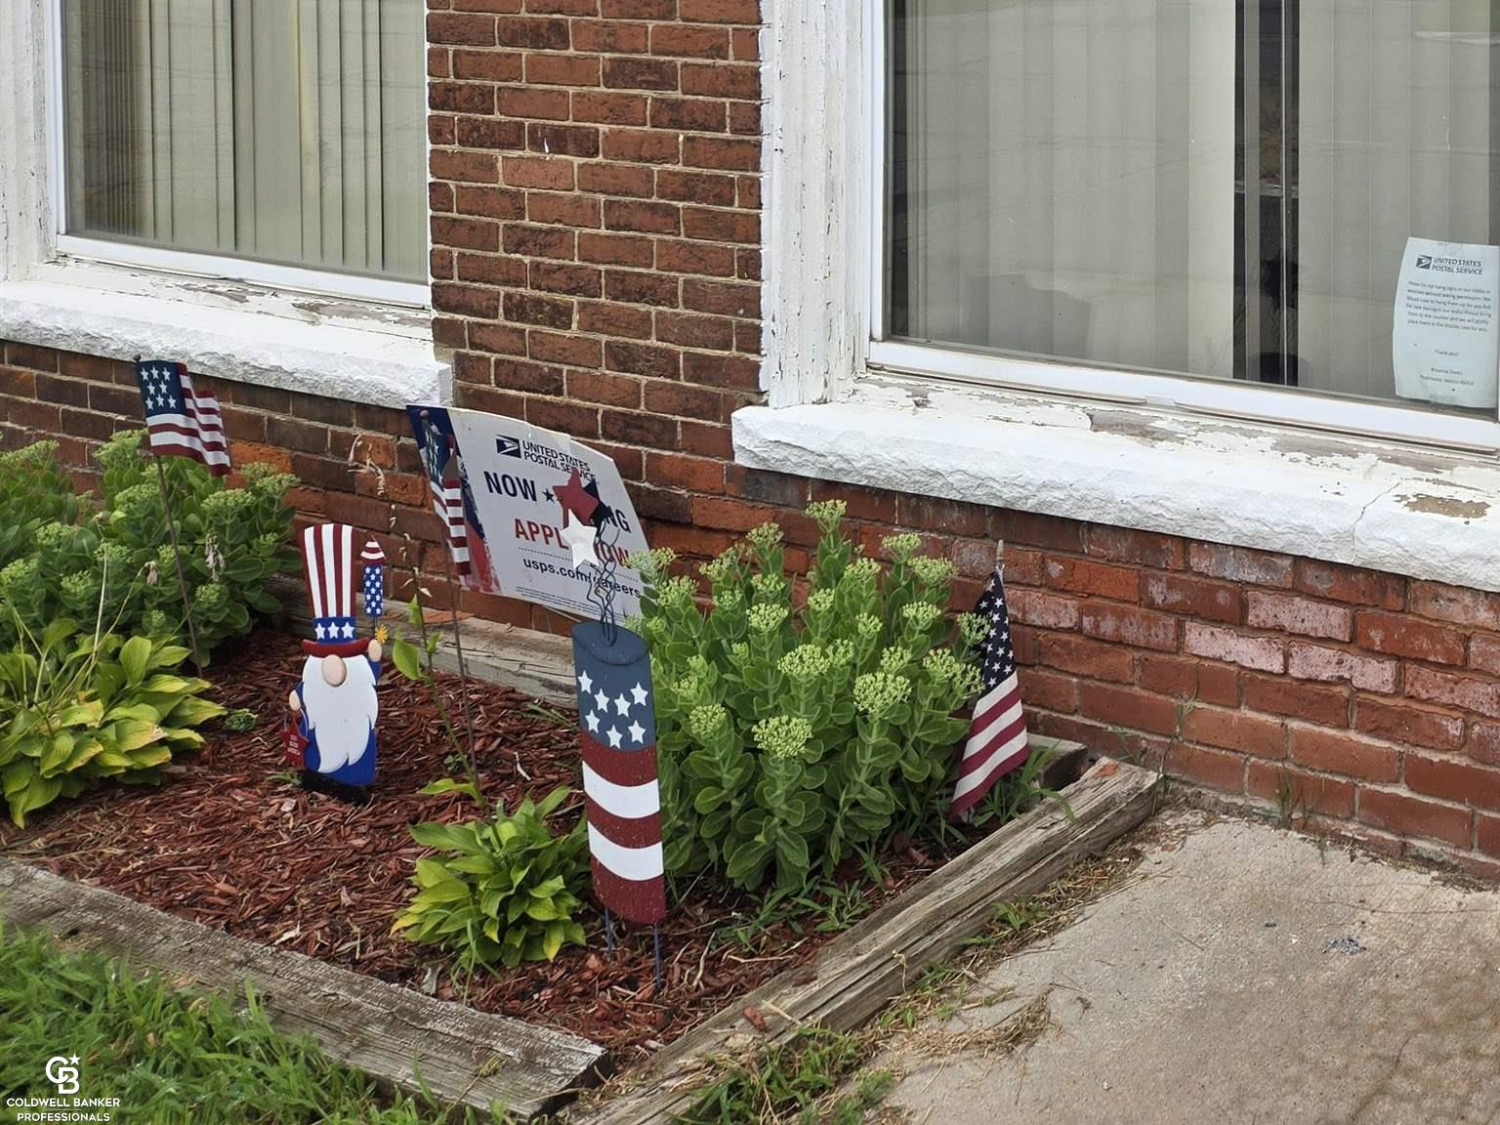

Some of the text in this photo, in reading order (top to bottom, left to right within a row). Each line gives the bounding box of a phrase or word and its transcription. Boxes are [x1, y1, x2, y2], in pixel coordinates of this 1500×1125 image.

[1432, 265, 1454, 273] POSTAL
[522, 440, 590, 473] UNITED STATES
[524, 451, 560, 471] POSTAL
[484, 472, 537, 502] NOW
[515, 518, 569, 551] APPL
